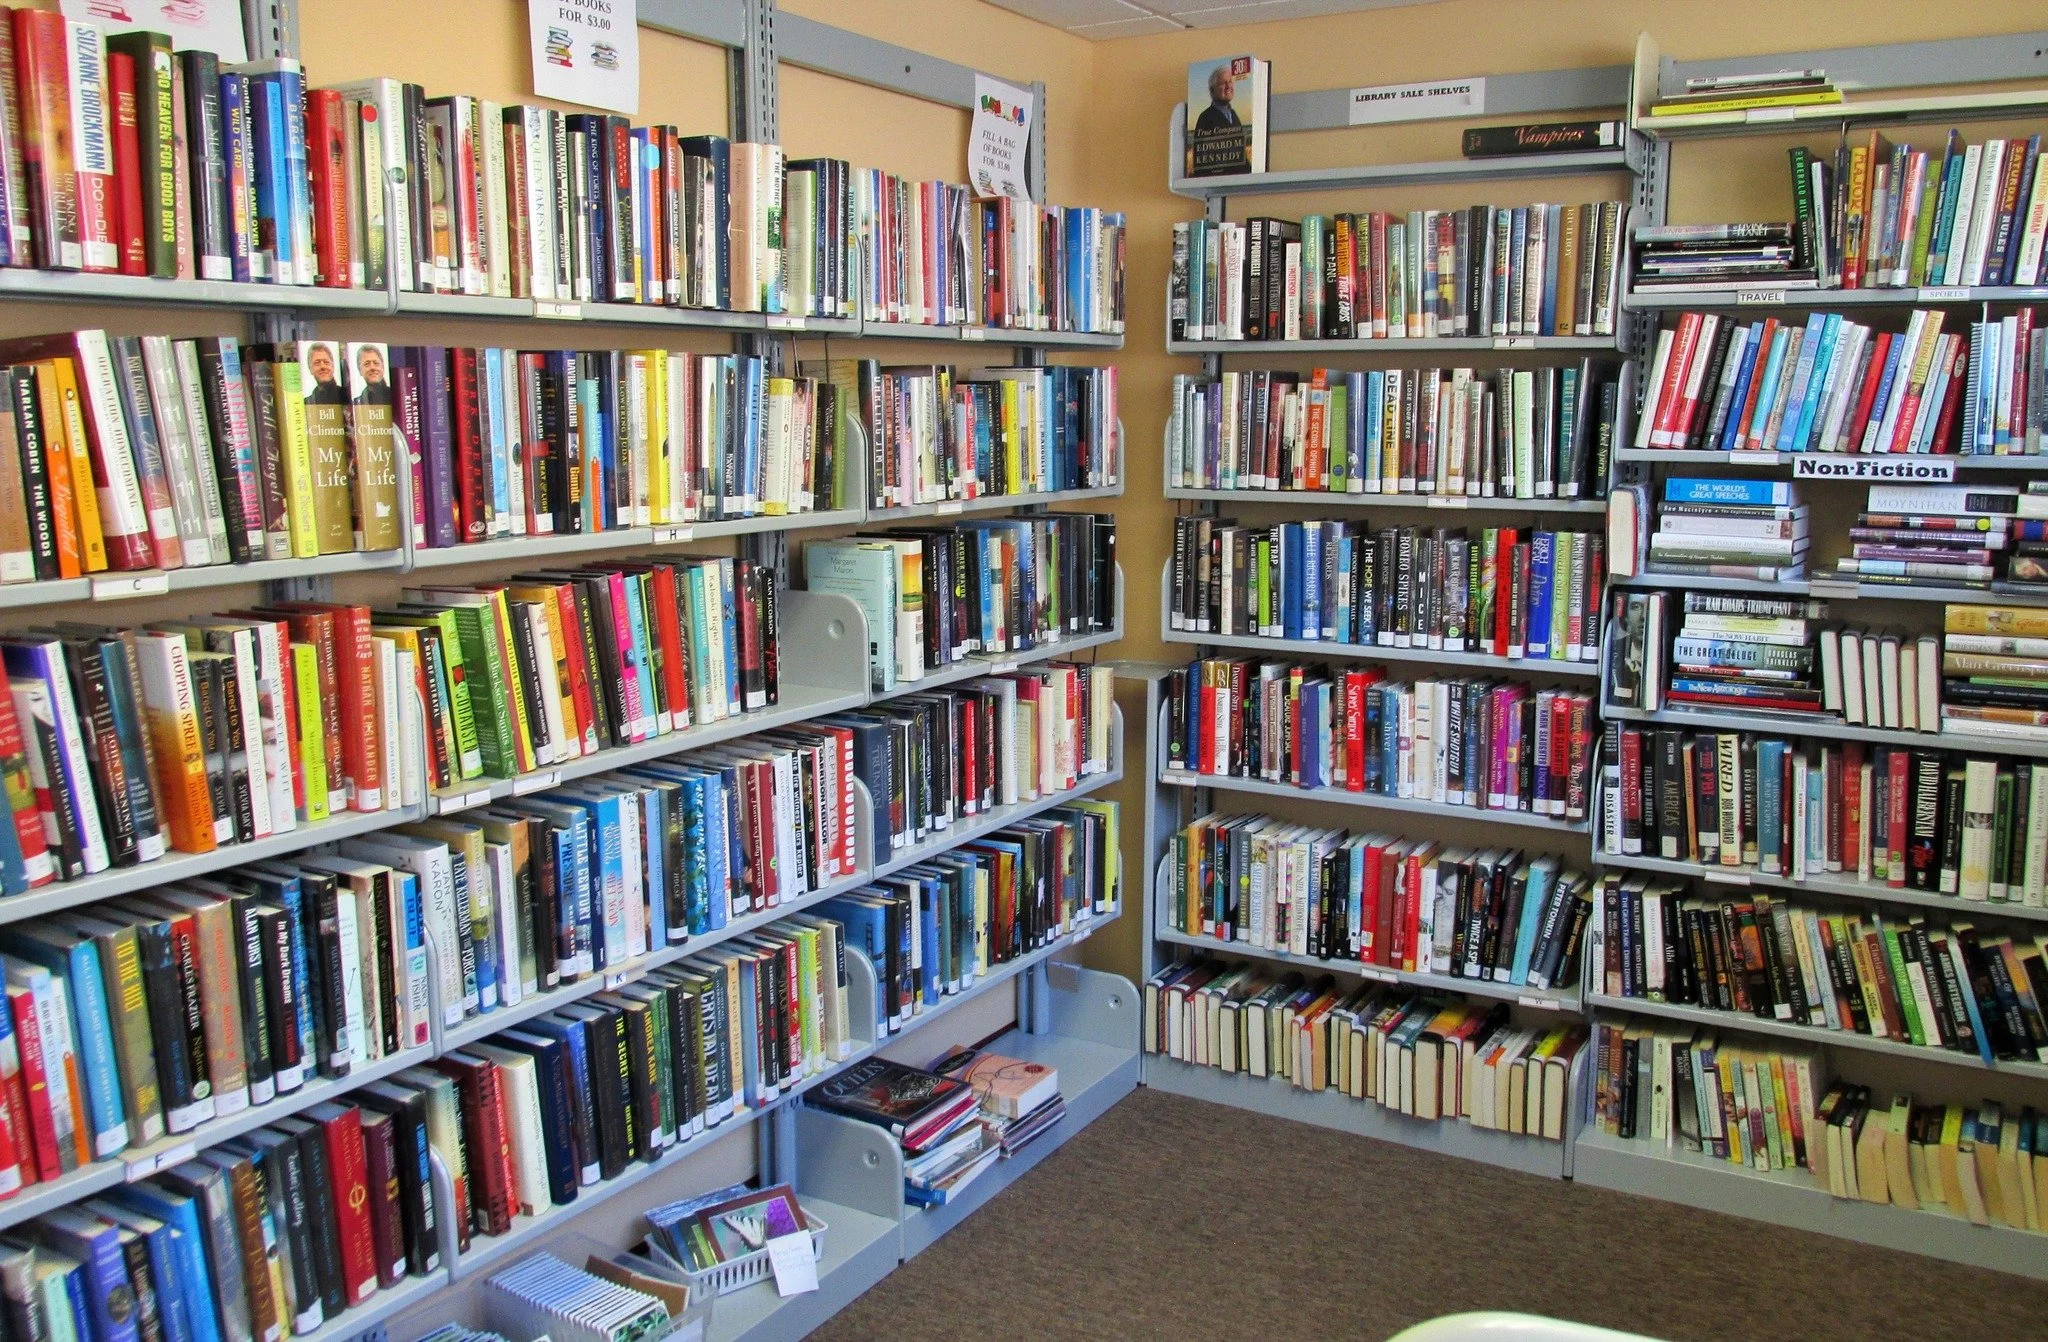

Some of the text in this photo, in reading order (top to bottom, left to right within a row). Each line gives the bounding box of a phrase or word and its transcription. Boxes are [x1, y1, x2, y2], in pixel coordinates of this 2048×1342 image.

[559, 8, 611, 30] FOR $3.00
[76, 27, 105, 170] SUZANNE BROCKMANN
[1355, 85, 1471, 102] LIBRARY SALE SHELVES
[230, 108, 242, 168] WILD CARD
[289, 104, 300, 145] BERG
[589, 120, 599, 159] THE KING
[982, 130, 1016, 149] FILL A BAG
[1514, 126, 1585, 147] Vampires
[241, 77, 259, 246] Cynthia GAME OVER
[982, 156, 995, 167] FOR
[983, 143, 1012, 160] OF BOOKS
[1196, 140, 1233, 152] EDWARD
[1196, 151, 1241, 164] KENNEDY
[158, 91, 175, 242] HEAVEN FOR GOOD BOYS
[1794, 157, 1809, 219] EMERALD MILE
[1997, 145, 2024, 253] SATURDAY RULES
[2030, 203, 2045, 234] WOMAN
[1270, 249, 1279, 271] JAMES
[1326, 256, 1336, 283] FANG
[554, 303, 562, 314] G
[1740, 293, 1781, 302] TRAVEL
[1929, 289, 1964, 298] SPORTS
[1509, 338, 1516, 347] P
[534, 371, 544, 439] JENNIFER HAIGH
[1386, 374, 1398, 414] DEAD
[308, 425, 345, 436] Clinton
[319, 409, 335, 420] Bill
[368, 409, 384, 420] Bill
[404, 395, 413, 435] KILLINGS
[411, 386, 420, 441] THE KENKEN
[567, 359, 580, 503] DAVID Gambit
[318, 447, 342, 467] My
[367, 447, 392, 467] My
[619, 437, 629, 467] JUDAS
[1309, 407, 1320, 478] THE SECOND OPINION
[20, 379, 51, 556] HARLAN COBEN THE WOODS
[264, 446, 281, 502] Angels
[316, 469, 348, 487] Life
[365, 468, 396, 486] Life
[1689, 490, 1749, 500] GREAT SPEECHES
[1694, 483, 1746, 493] THE WORLD'S
[1876, 499, 1958, 511] MOYNIHAN
[669, 529, 678, 540] H
[1269, 527, 1278, 565] THE TRAP
[1531, 537, 1540, 564] SEGAL
[1540, 538, 1549, 564] ERICH
[132, 579, 142, 591] C
[1305, 560, 1317, 600] RICHARDS
[1363, 548, 1373, 624] THE HOPE WE SEEK
[1397, 536, 1410, 611] ROMEO SPIKES
[1569, 537, 1583, 608] KARIN SLAUGHTER
[766, 597, 774, 635] JACOBSON
[1705, 597, 1745, 612] RAILROADS
[1587, 615, 1599, 647] UNSEEN
[322, 620, 335, 685] KIM EDWARDS
[588, 646, 598, 680] KNOWN
[1678, 646, 1757, 661] THE GREAT DELUGE
[1767, 649, 1798, 659] DOUGLAS
[170, 646, 197, 750] CHOPPING SPREE
[227, 680, 241, 748] Bared You
[330, 709, 339, 734] LAKE
[360, 666, 376, 781] NATHAN ENGLANDER
[1384, 721, 1393, 752] shiver
[1449, 700, 1461, 775] WHITE SHOTGUN
[106, 733, 132, 831] JOHN DUNNING
[1720, 740, 1734, 845] WIRED WOODWARD
[1915, 761, 1940, 838] DAVID HALBERSTAM
[238, 784, 252, 828] SYLVIA DAY
[1605, 793, 1614, 835] DISASTER
[1664, 780, 1680, 826] AMERICAS
[820, 805, 829, 844] KEILLOR
[430, 859, 443, 911] KARON
[441, 869, 452, 896] JAN
[561, 843, 573, 899] PRESSURE
[575, 821, 591, 920] LITTLE CENTURY
[456, 886, 472, 936] KELLERMAN
[1543, 883, 1566, 938] PETER TONKIN
[244, 908, 262, 968] ALAN FURST
[1469, 920, 1482, 943] TWICE
[119, 959, 139, 984] THE
[277, 932, 292, 1004] My Dark Dreams
[1664, 943, 1674, 962] Alibi
[179, 933, 200, 1030] CHARLES FRAZIER
[411, 978, 422, 1012] FISHER
[615, 972, 626, 984] K
[1939, 952, 1966, 1022] JAMES PATTERSON
[701, 991, 716, 1056] CRYSTAL
[643, 1012, 657, 1085] ANDREA KANE
[153, 1156, 164, 1168] F
